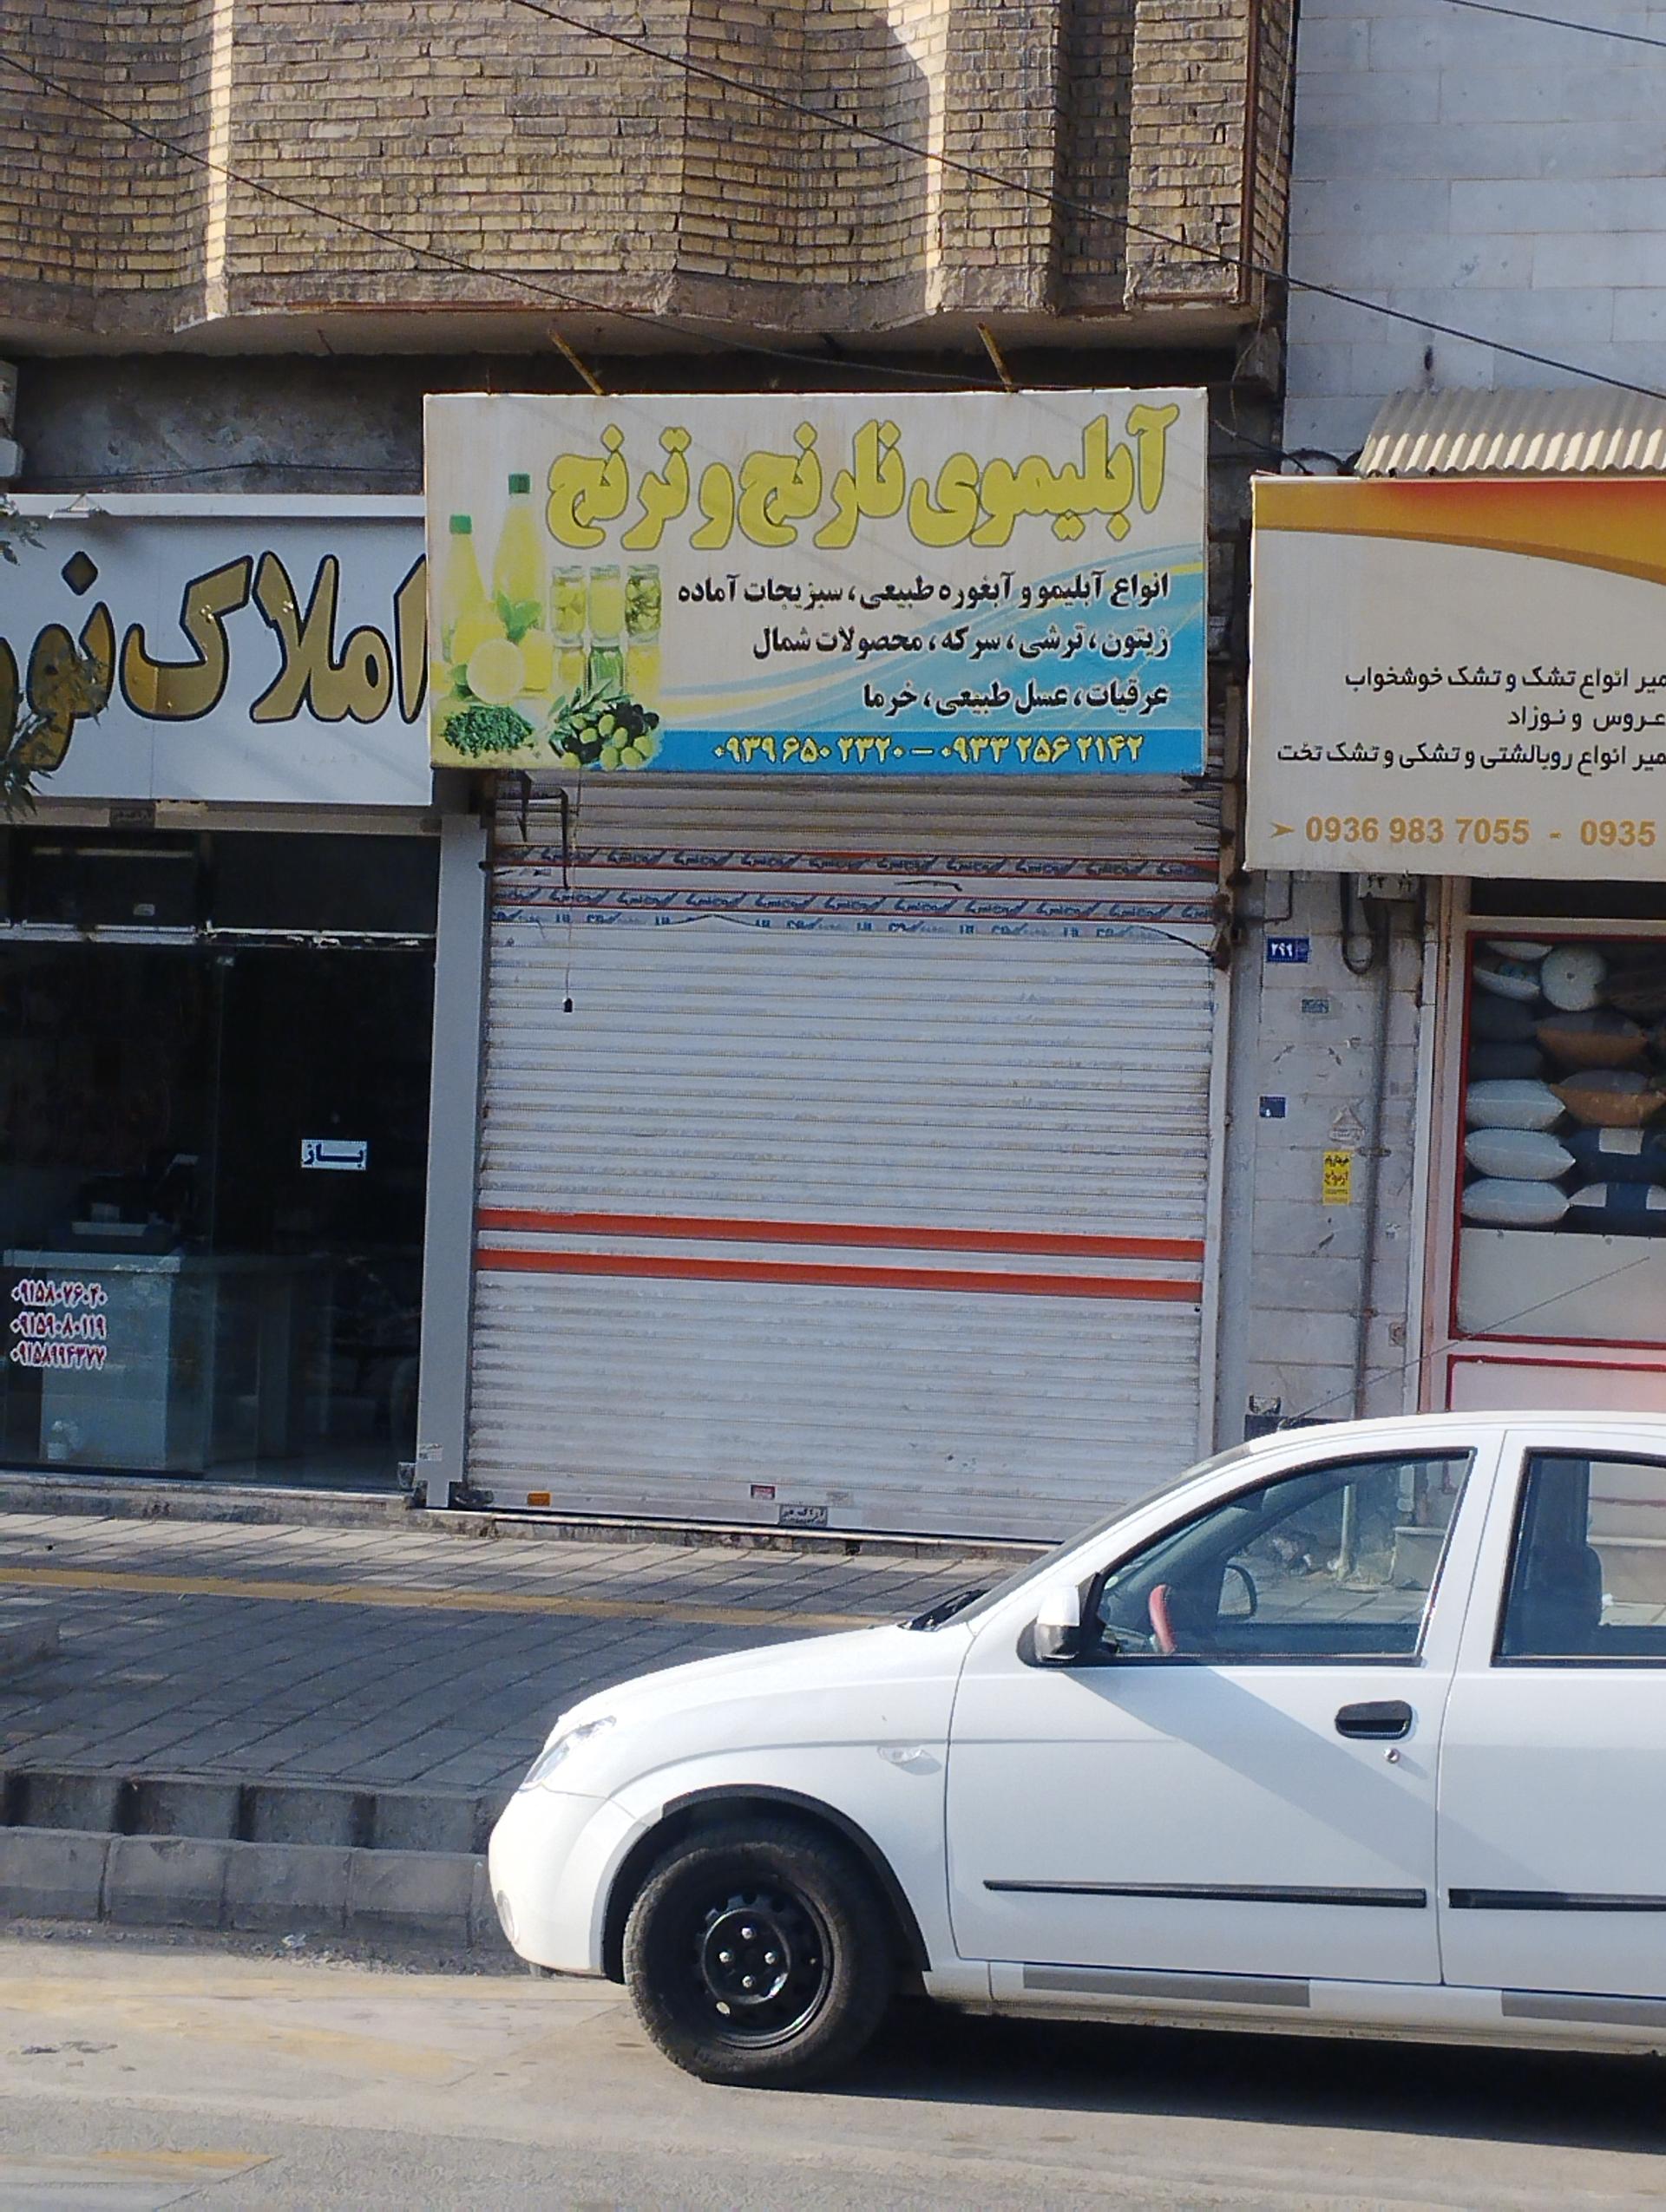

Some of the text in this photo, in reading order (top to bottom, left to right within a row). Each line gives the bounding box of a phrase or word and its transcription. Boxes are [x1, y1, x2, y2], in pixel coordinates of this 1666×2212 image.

[546, 403, 1180, 551] آبلیموی نارنج و ترنج
[678, 573, 741, 603] آماده
[744, 577, 843, 611] سبزیجات
[938, 570, 1015, 609] آبغوره
[1019, 584, 1033, 609] و
[1034, 570, 1107, 608] آبلیمو
[1110, 571, 1168, 608] انواع
[752, 625, 811, 660] شمال
[816, 625, 923, 660] محصولات
[1345, 665, 1444, 692] خوشخواب
[1447, 665, 1503, 687] تشک
[1505, 672, 1517, 693] و
[1522, 665, 1577, 687] تشک
[1578, 667, 1629, 699] انواع
[863, 681, 918, 717] خرما
[1014, 679, 1068, 715] عسل
[1507, 705, 1566, 731] نوزاد
[1571, 711, 1583, 732] و
[714, 736, 777, 764] ۰۹۳۹
[782, 736, 831, 764] ۶۵۰
[941, 736, 1011, 764] ۰۹۳۳
[1015, 736, 1072, 764] ۲۵۶
[1277, 742, 1324, 762] تخت
[1326, 742, 1381, 762] تشک
[1382, 749, 1394, 769] و
[1399, 743, 1461, 769] تشکی
[1464, 749, 1476, 769] و
[1577, 744, 1627, 777] انواع
[1305, 815, 1380, 843] 0936
[1389, 817, 1445, 844] 983
[1455, 818, 1531, 845] 7055
[1580, 820, 1656, 847] 0935
[303, 1142, 364, 1168] باز
